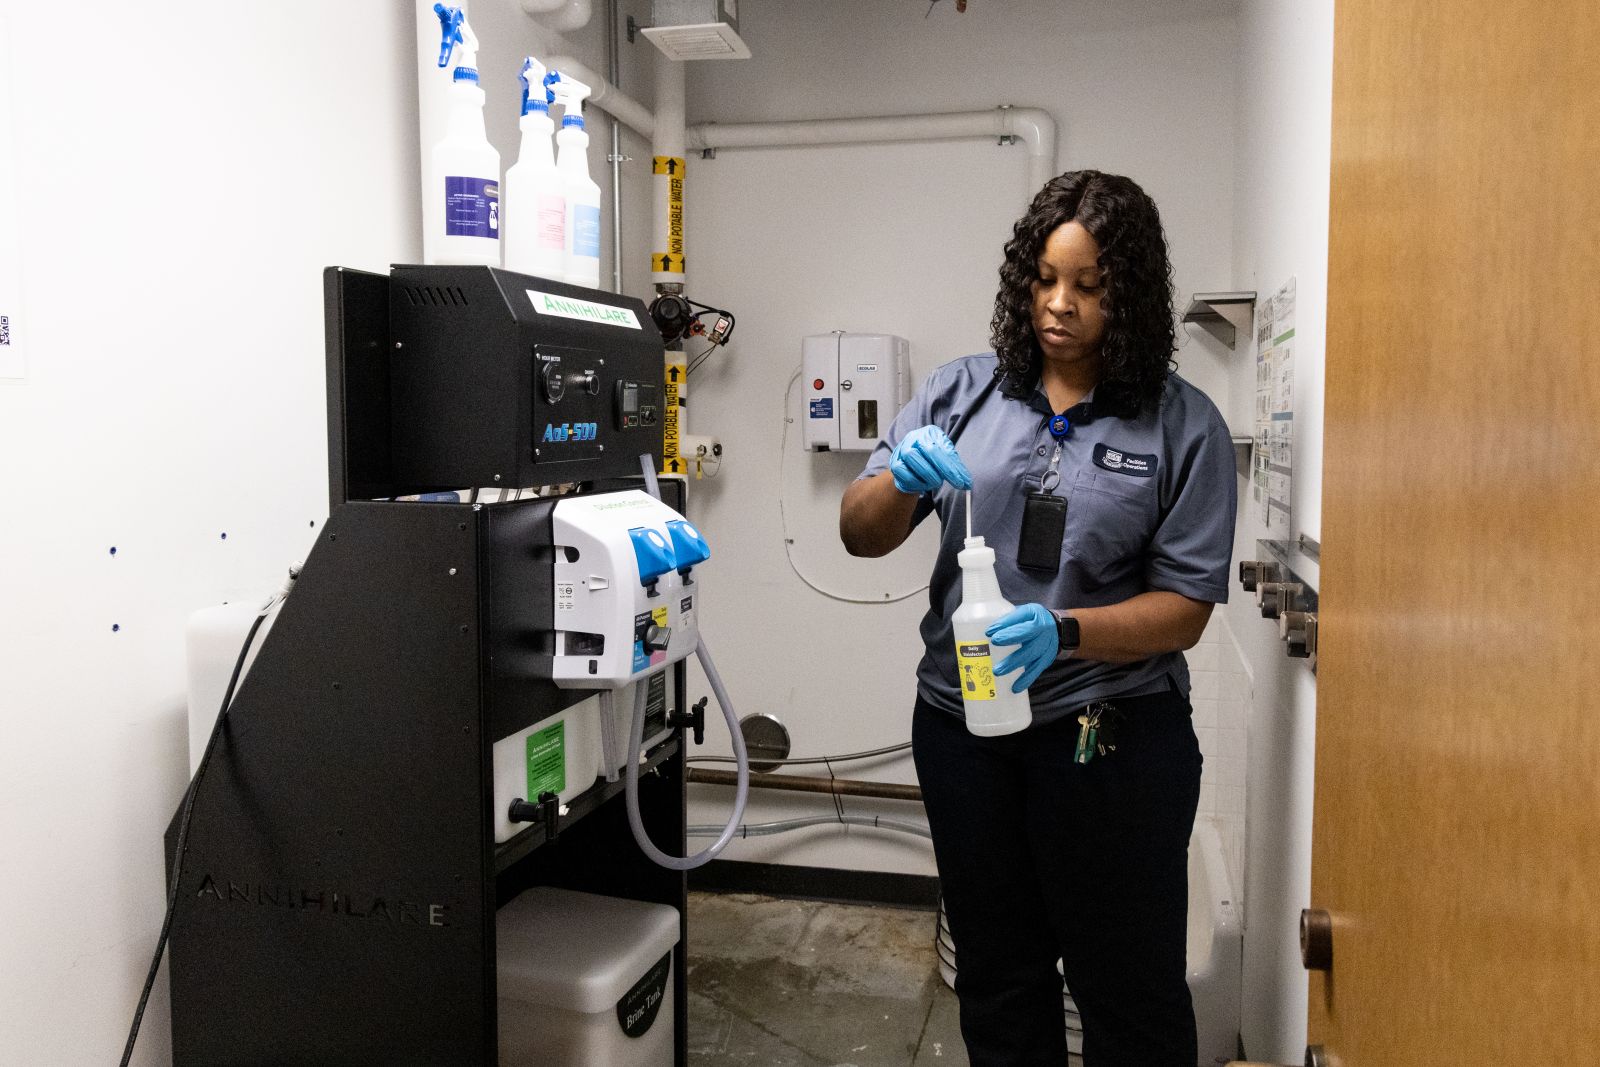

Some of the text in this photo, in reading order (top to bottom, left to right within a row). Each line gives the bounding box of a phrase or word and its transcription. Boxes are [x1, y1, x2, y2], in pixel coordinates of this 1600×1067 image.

[671, 178, 682, 254] NON POTABLE WATER
[543, 295, 631, 324] ANNIHILARE
[664, 383, 677, 458] NON POTABLE WATER
[1122, 463, 1148, 471] Operations
[1126, 458, 1147, 466] Facilities
[989, 689, 996, 698] 5
[197, 873, 450, 927] ANNIHILARE
[626, 985, 661, 1029] Brine Tank
